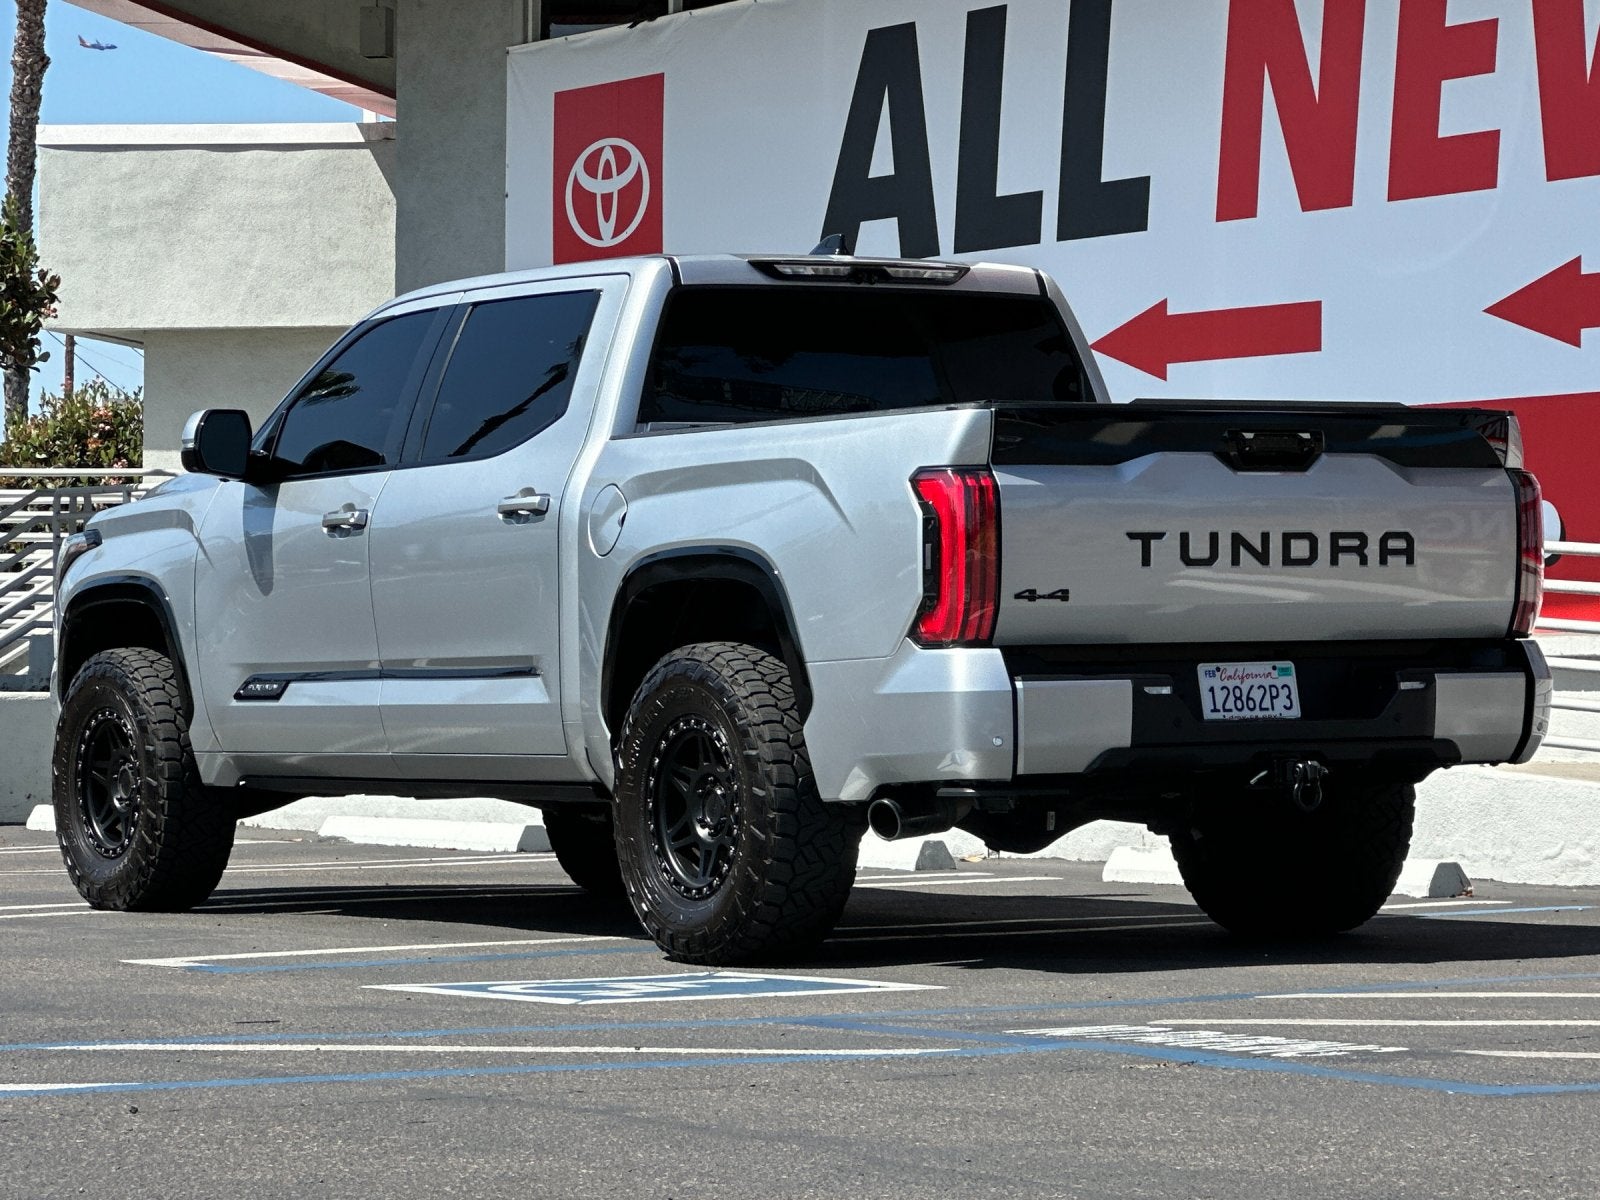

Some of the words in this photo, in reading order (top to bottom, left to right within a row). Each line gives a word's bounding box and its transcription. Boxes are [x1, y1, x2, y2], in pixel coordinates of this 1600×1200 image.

[822, 0, 1151, 259] ALL
[1125, 531, 1415, 567] TUNDRA
[1205, 669, 1217, 678] FEB
[1220, 667, 1279, 685] California
[1208, 684, 1294, 713] 12862P3
